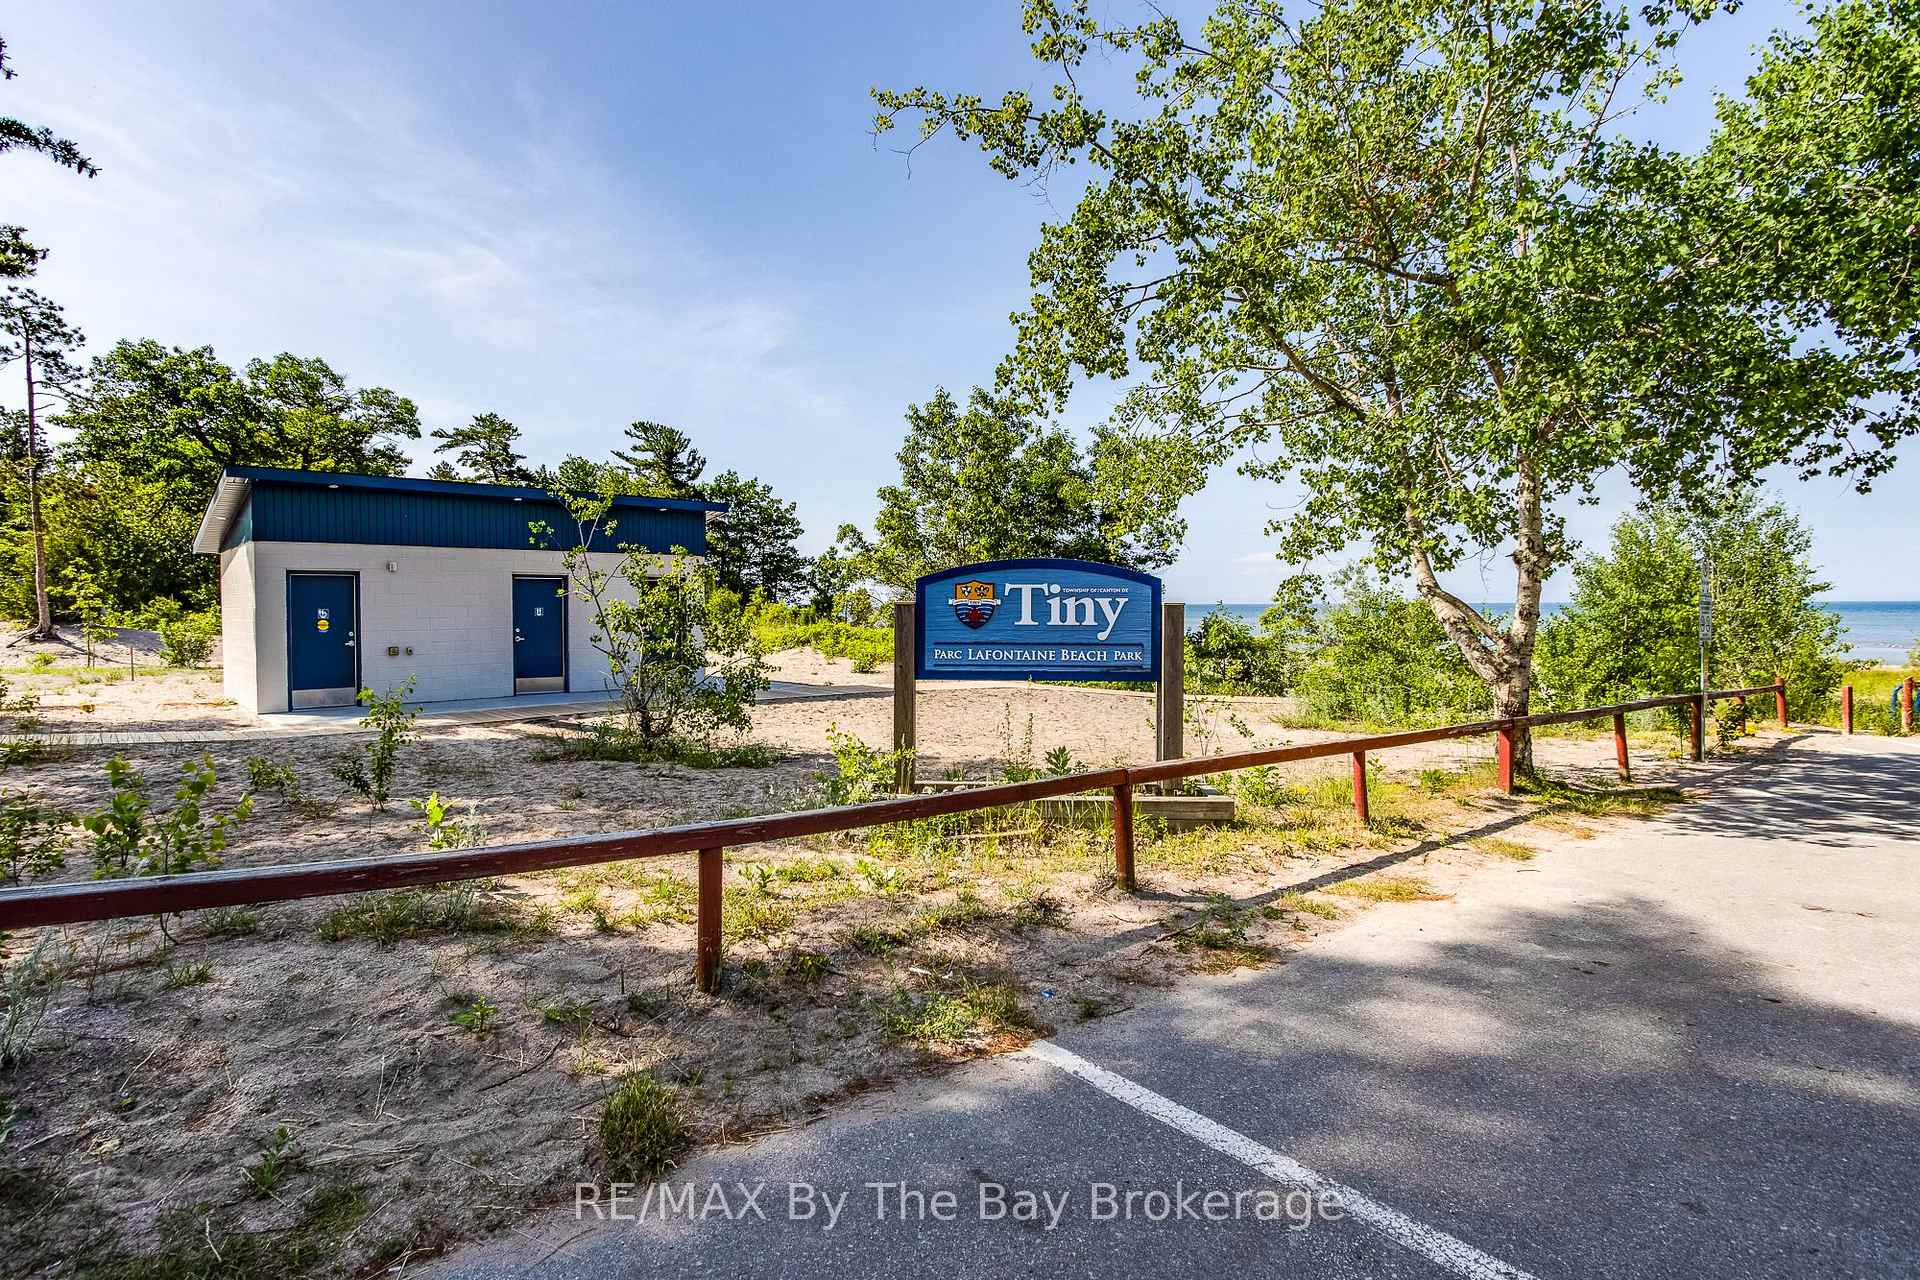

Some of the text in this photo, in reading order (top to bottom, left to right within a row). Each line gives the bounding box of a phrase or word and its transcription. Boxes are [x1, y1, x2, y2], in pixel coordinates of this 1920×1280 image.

[1005, 582, 1129, 641] Tiny
[934, 648, 1143, 661] PARC LAFONTAINE BEACH PARK
